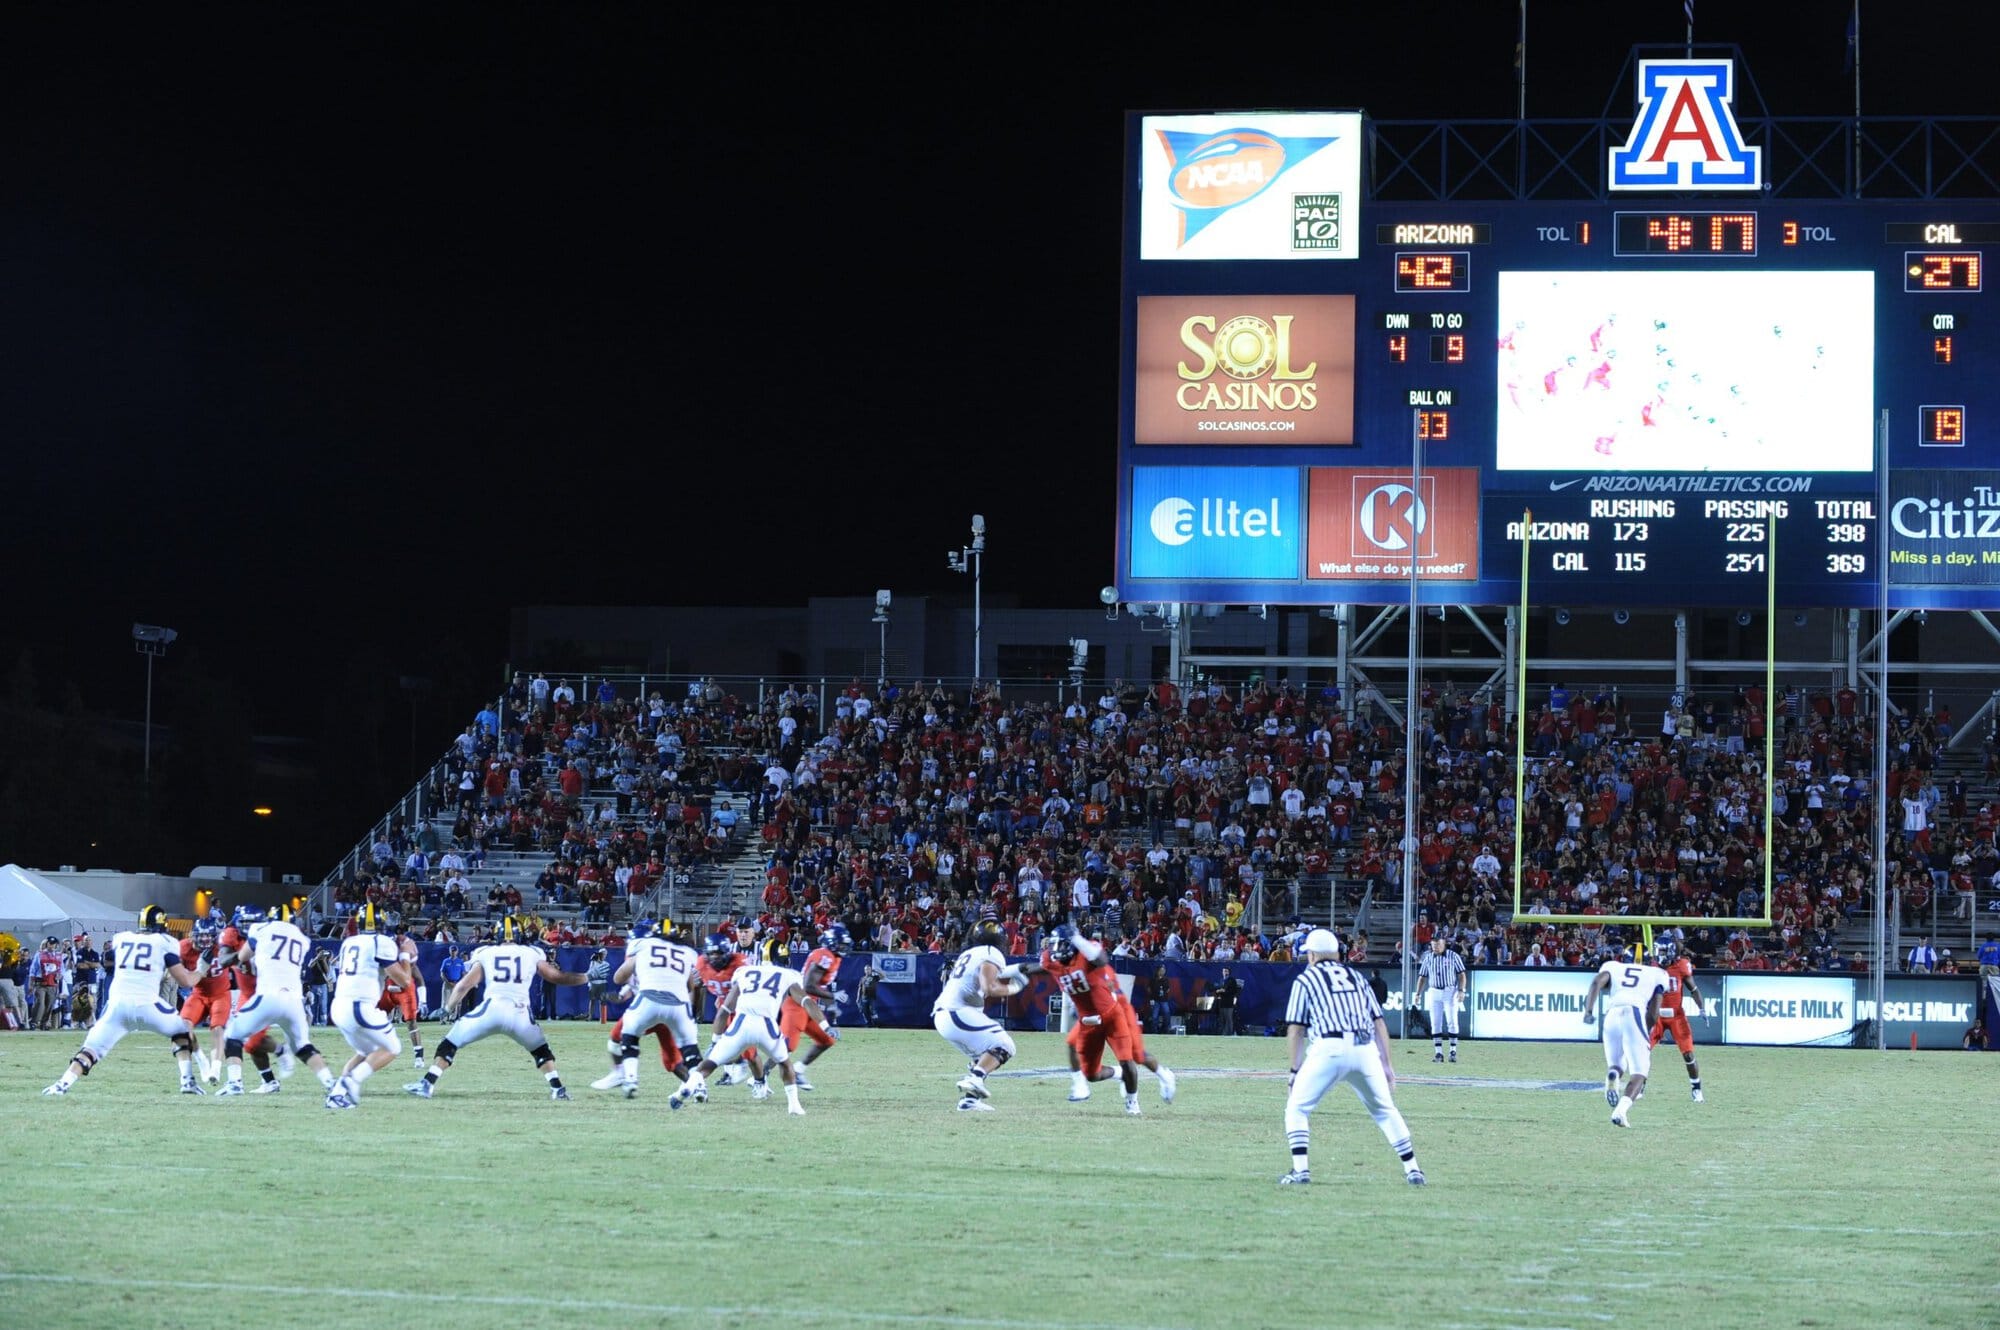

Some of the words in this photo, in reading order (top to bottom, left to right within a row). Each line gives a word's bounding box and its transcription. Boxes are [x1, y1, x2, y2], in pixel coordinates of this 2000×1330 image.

[1609, 59, 1761, 191] A
[1187, 159, 1264, 190] NCAA
[1295, 207, 1338, 220] PAC
[1296, 221, 1338, 239] 10
[1395, 225, 1473, 243] ARIZONA
[1537, 227, 1570, 241] TOL
[1582, 223, 1589, 244] 1
[1649, 216, 1753, 251] 4:17
[1783, 222, 1797, 245] 3
[1802, 227, 1835, 241] TOL
[1925, 225, 1961, 243] CAL
[1295, 239, 1337, 248] FOOTBALL
[1399, 256, 1452, 287] 42
[1923, 256, 1978, 287] 27
[1386, 314, 1409, 328] DWN
[1431, 314, 1444, 328] TO
[1447, 314, 1462, 328] GO
[1933, 314, 1953, 330] QTR
[1178, 315, 1317, 381] SOL
[1390, 335, 1406, 361] 4
[1447, 335, 1463, 361] 9
[1935, 336, 1951, 362] 4
[1177, 383, 1317, 410] CASINOS
[1410, 391, 1434, 405] BALL
[1436, 391, 1451, 405] ON
[1198, 421, 1295, 431] SOLCASINOS.COM
[1936, 411, 1961, 441] 19
[1584, 476, 1812, 493] ARIZONAATHLETICS.COM
[1173, 498, 1282, 538] alltel
[1590, 500, 1675, 518] RUSHING
[1705, 500, 1788, 518] PASSING
[1815, 501, 1876, 519] TOTAL
[1891, 497, 2000, 539] Citiz
[1613, 523, 1648, 541] 173
[1726, 523, 1765, 542] 225
[1827, 524, 1865, 542] 398
[1319, 563, 1351, 573] What
[1354, 563, 1380, 574] else
[1383, 563, 1399, 574] do
[1426, 563, 1465, 574] need?
[1552, 552, 1589, 571] CAL
[1615, 553, 1646, 571] 115
[1827, 554, 1865, 573] 369
[1891, 551, 1928, 564] Miss
[1932, 554, 1942, 564] a
[1946, 552, 1977, 566] day.
[675, 875, 689, 884] 26
[119, 941, 152, 972] 72
[271, 934, 303, 966] 70
[650, 945, 684, 974] 55
[493, 956, 523, 984] 51
[1322, 965, 1356, 993] R
[1621, 967, 1642, 988] 5
[743, 970, 782, 998] 34
[1477, 991, 1544, 1012] MUSCLE
[1729, 998, 1797, 1018] MUSCLE
[1801, 1000, 1844, 1019] MILK
[1925, 1001, 1969, 1023] MILK
